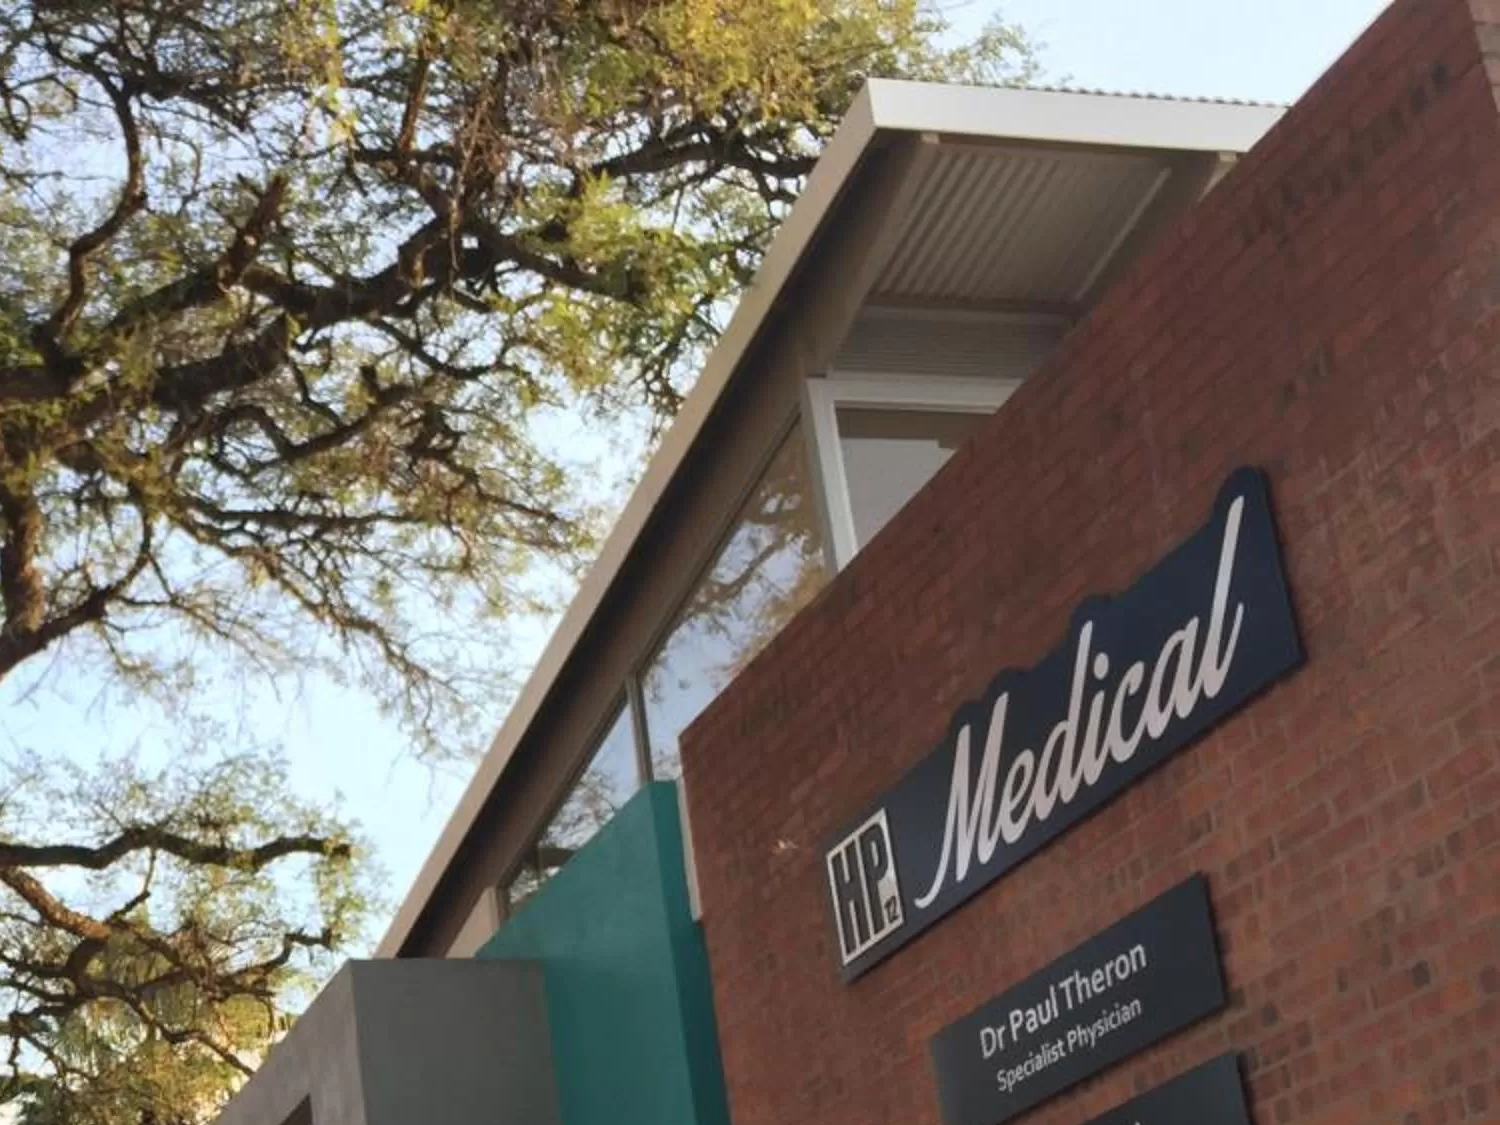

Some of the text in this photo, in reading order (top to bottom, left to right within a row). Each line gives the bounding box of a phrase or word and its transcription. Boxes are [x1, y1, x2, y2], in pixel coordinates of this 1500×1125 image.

[830, 823, 890, 956] HP
[915, 496, 1244, 908] Medical
[980, 943, 1147, 1059] Dr Paul Theron
[997, 998, 1142, 1093] Specialist Physician
